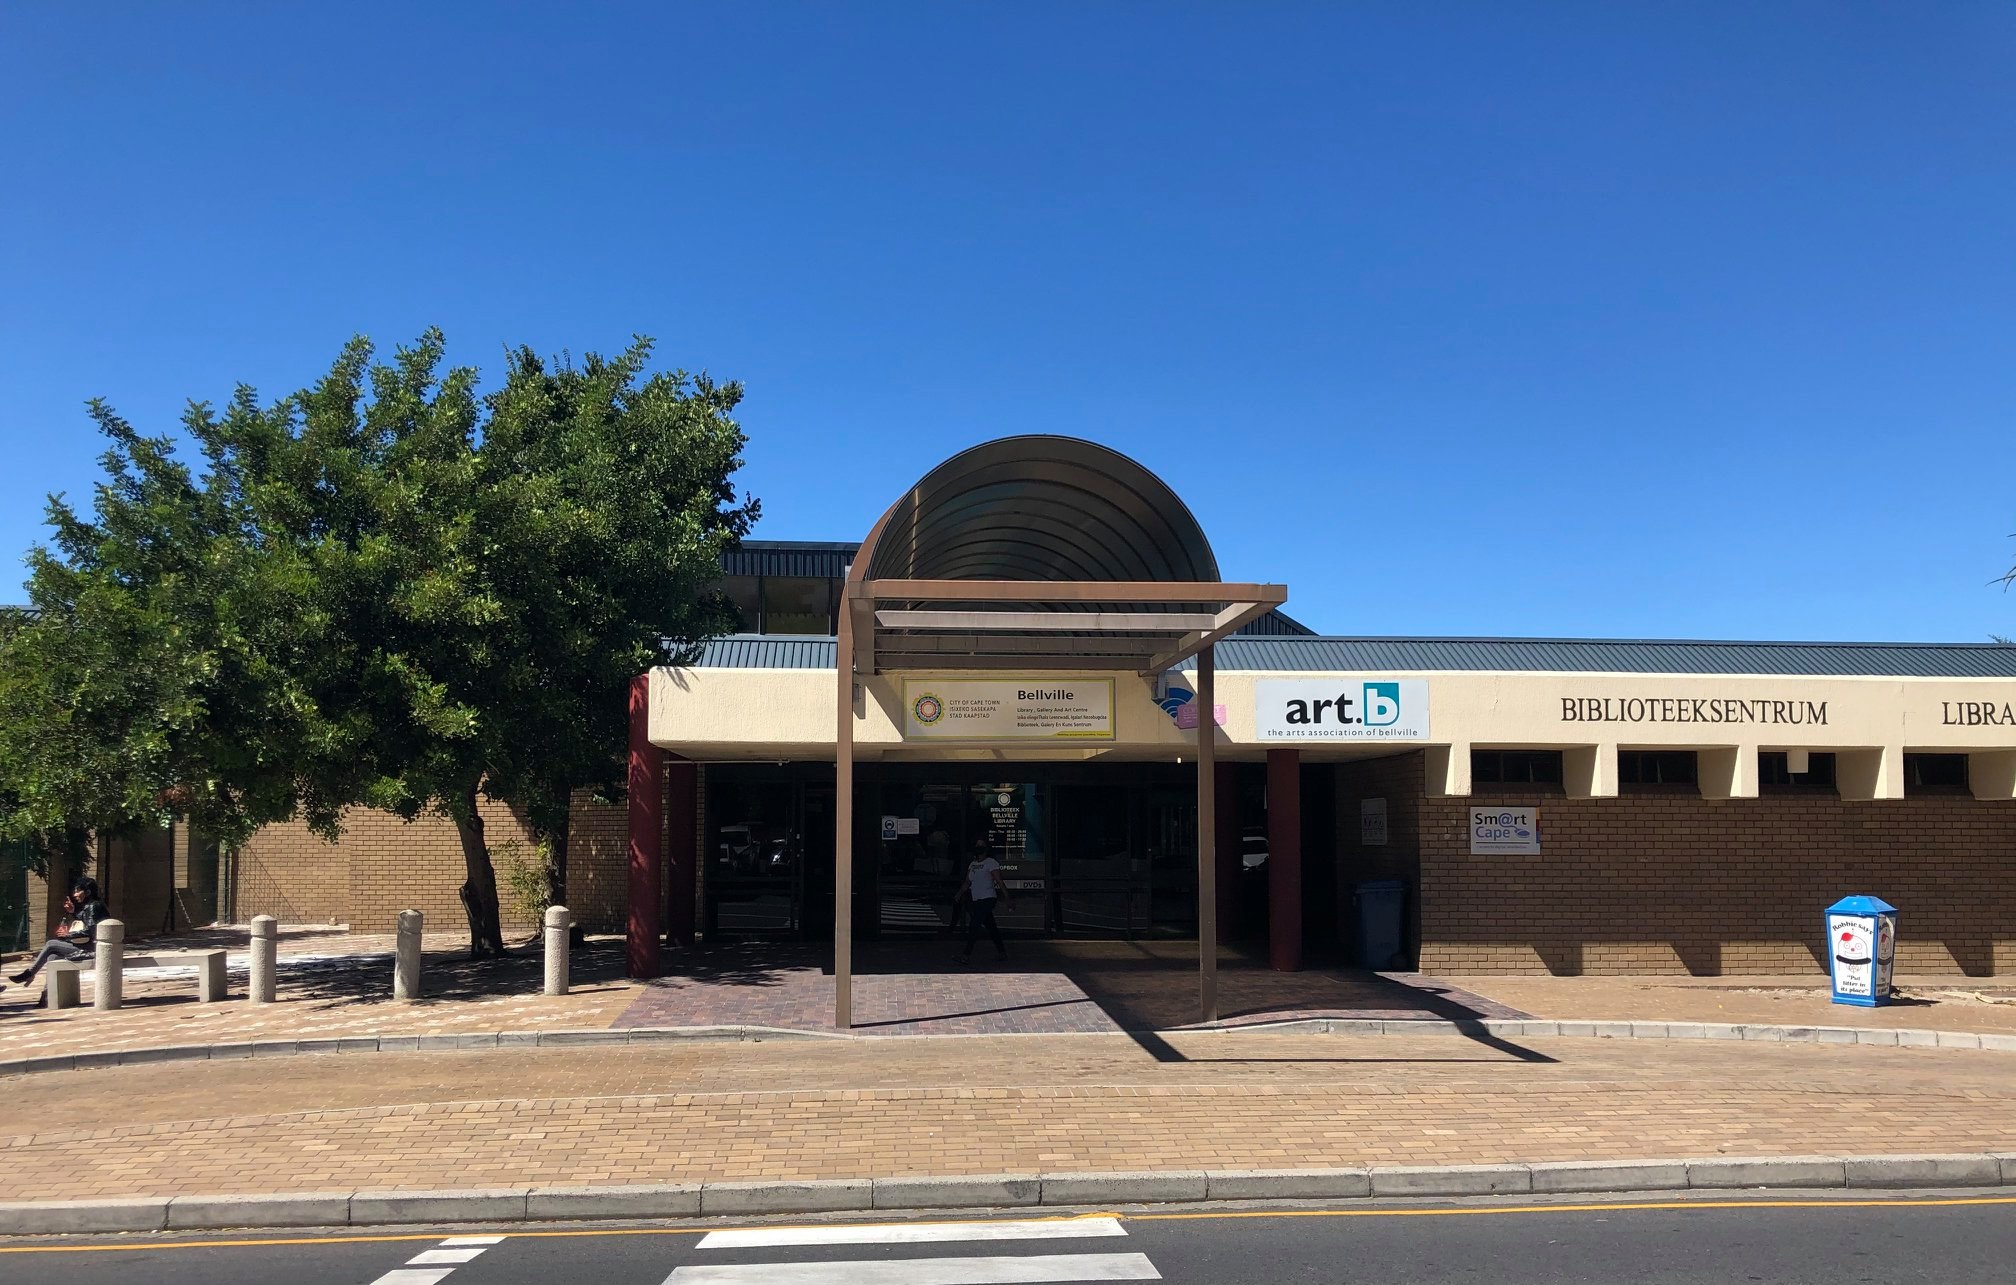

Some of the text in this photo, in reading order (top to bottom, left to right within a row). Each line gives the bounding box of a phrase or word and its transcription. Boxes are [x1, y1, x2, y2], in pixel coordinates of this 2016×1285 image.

[1017, 689, 1074, 700] Bellville
[1285, 684, 1399, 725] art.b
[1560, 697, 1829, 725] BIBLIOTEEKSENTRUM
[1267, 728, 1418, 737] the arts association of bellville
[1475, 812, 1527, 828] Sm@rt
[1475, 826, 1510, 841] Cape
